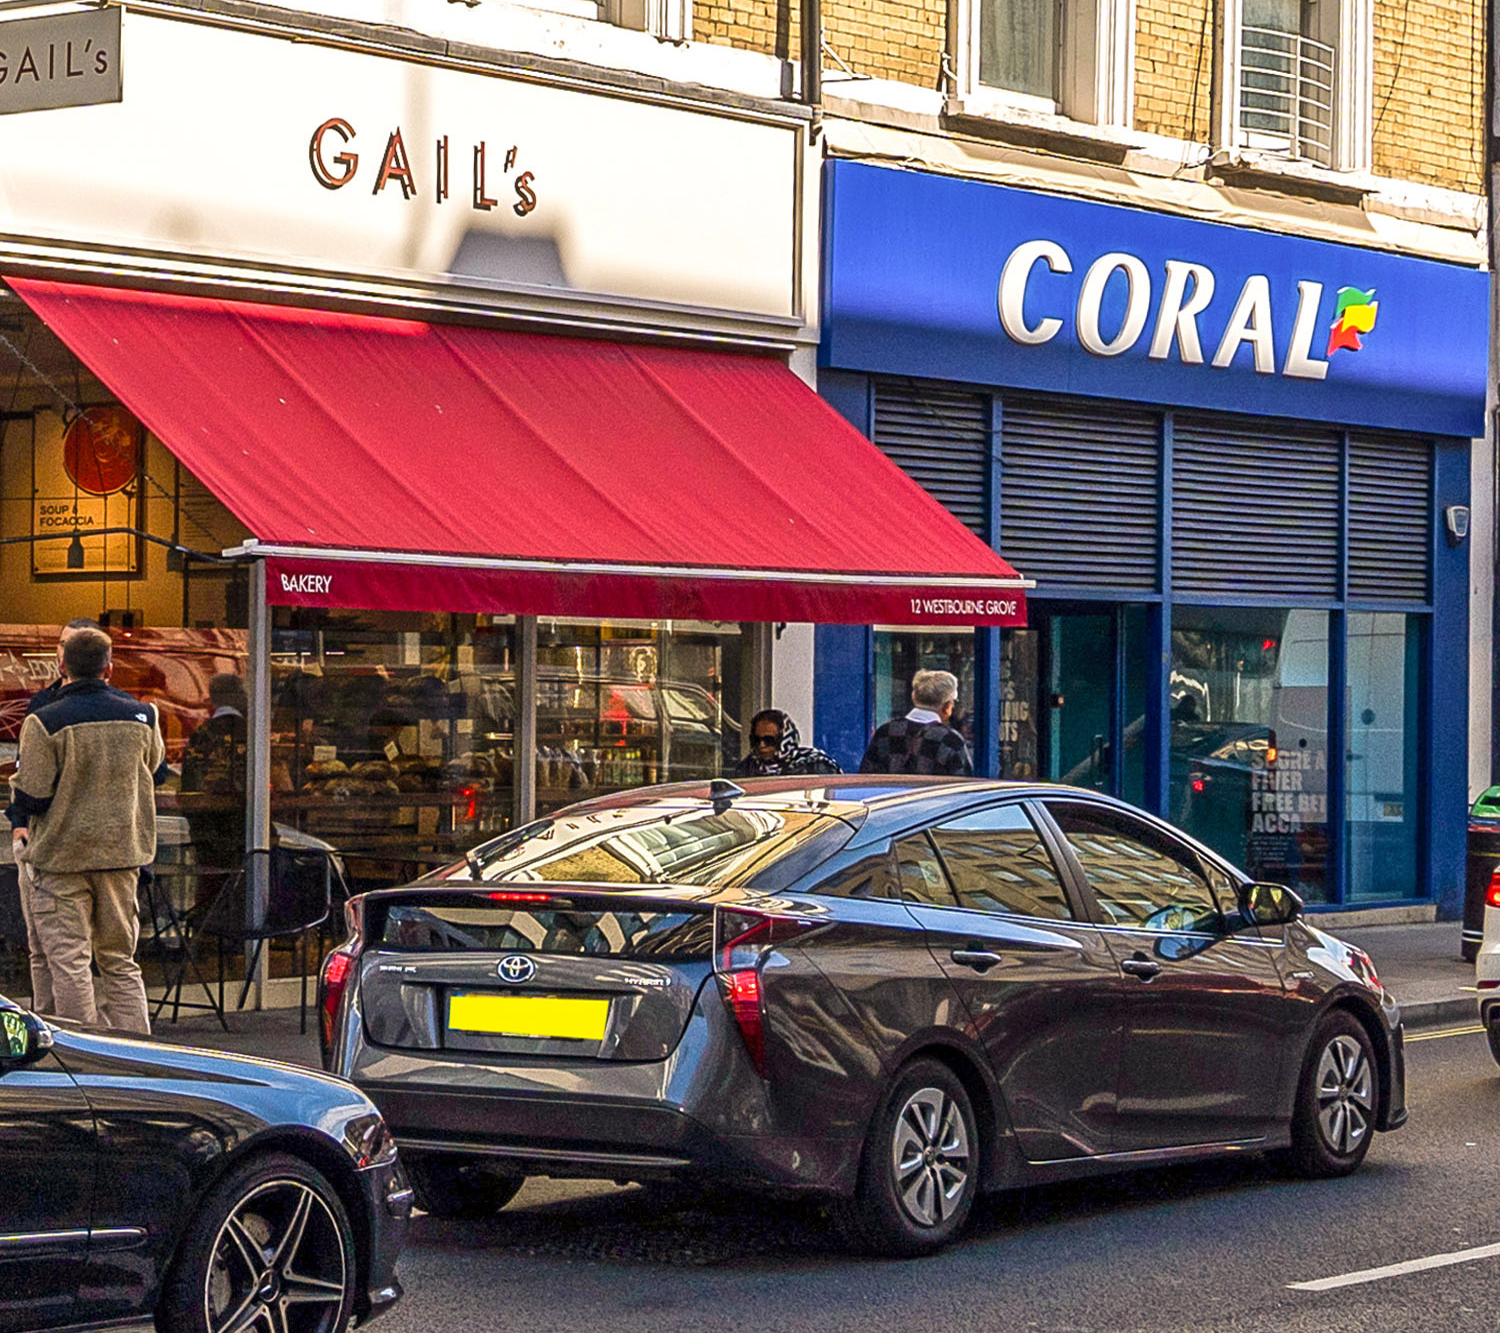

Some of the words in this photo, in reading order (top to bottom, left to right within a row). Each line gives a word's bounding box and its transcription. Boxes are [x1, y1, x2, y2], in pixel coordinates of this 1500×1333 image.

[308, 116, 538, 217] GAIL's
[997, 239, 1330, 381] CORAL
[39, 505, 69, 515] SOUP
[39, 516, 94, 526] FOCACCIA
[280, 573, 332, 593] BAKERY
[910, 599, 920, 613] 12
[922, 599, 984, 615] WESTBOURNE
[985, 600, 1017, 616] GROVE
[1252, 792, 1294, 812] FREE
